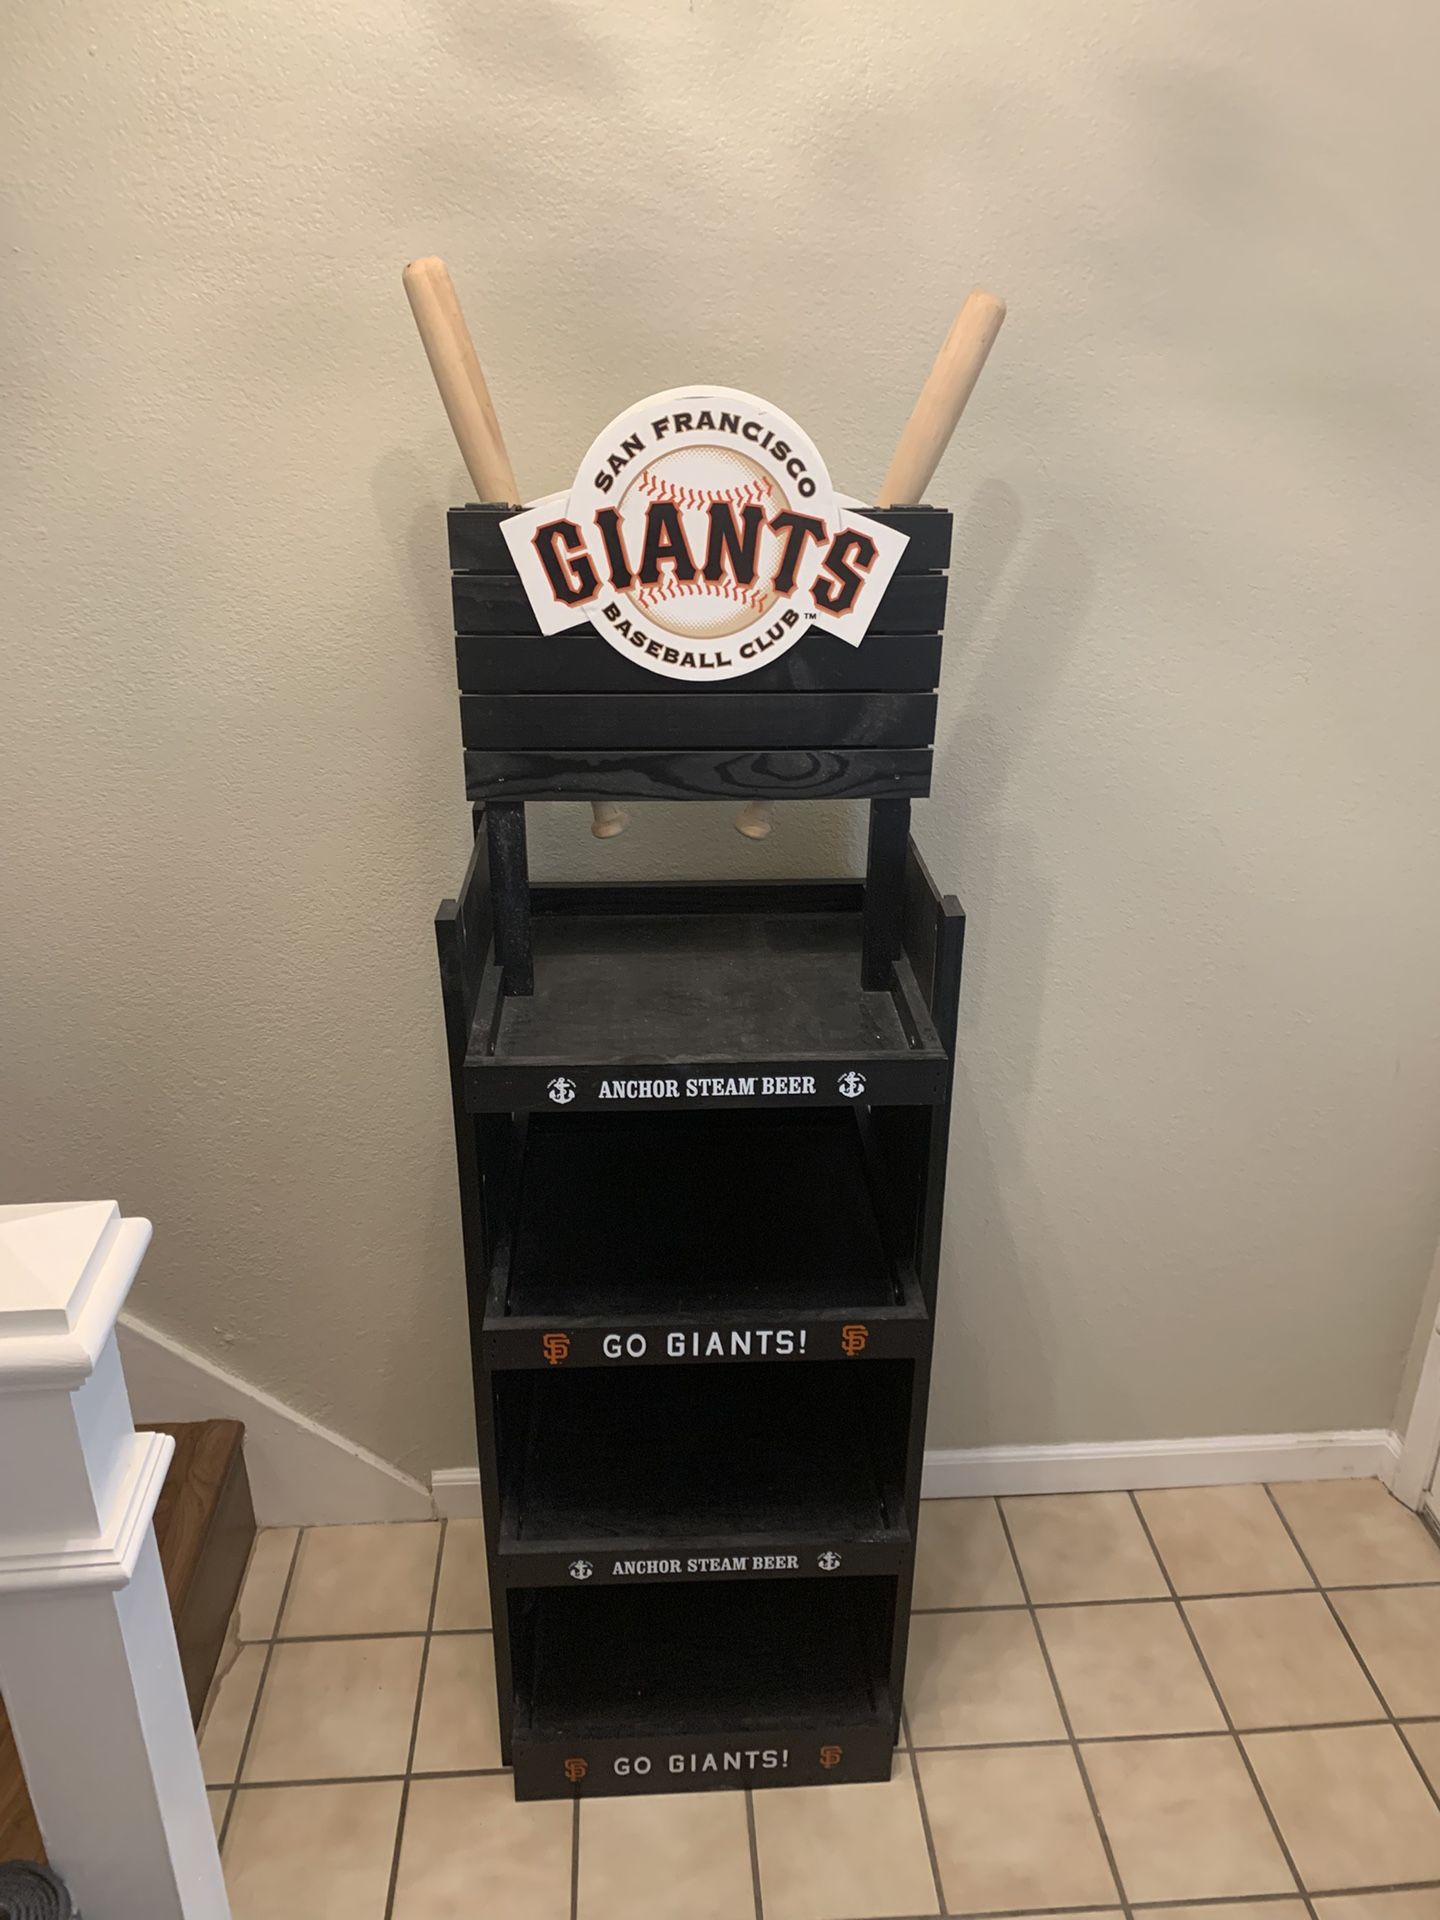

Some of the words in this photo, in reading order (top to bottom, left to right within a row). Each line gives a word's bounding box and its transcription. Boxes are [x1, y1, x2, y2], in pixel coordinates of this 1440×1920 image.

[594, 432, 647, 494] SAN
[651, 410, 817, 498] FRANCISCO
[531, 500, 880, 619] GIANTS
[601, 602, 733, 669] BASEBALL
[738, 608, 801, 660] CLUB
[598, 1080, 680, 1098] ANCHOR
[686, 1077, 756, 1097] STEAM
[761, 1076, 816, 1095] BEER
[603, 1334, 647, 1358] GO
[667, 1330, 807, 1357] GIANTS!
[612, 1560, 682, 1575] ANCHOR
[687, 1558, 748, 1572] STEAM
[752, 1555, 799, 1570] BEER
[614, 1757, 651, 1775] GO
[669, 1750, 788, 1773] GIANTS!
